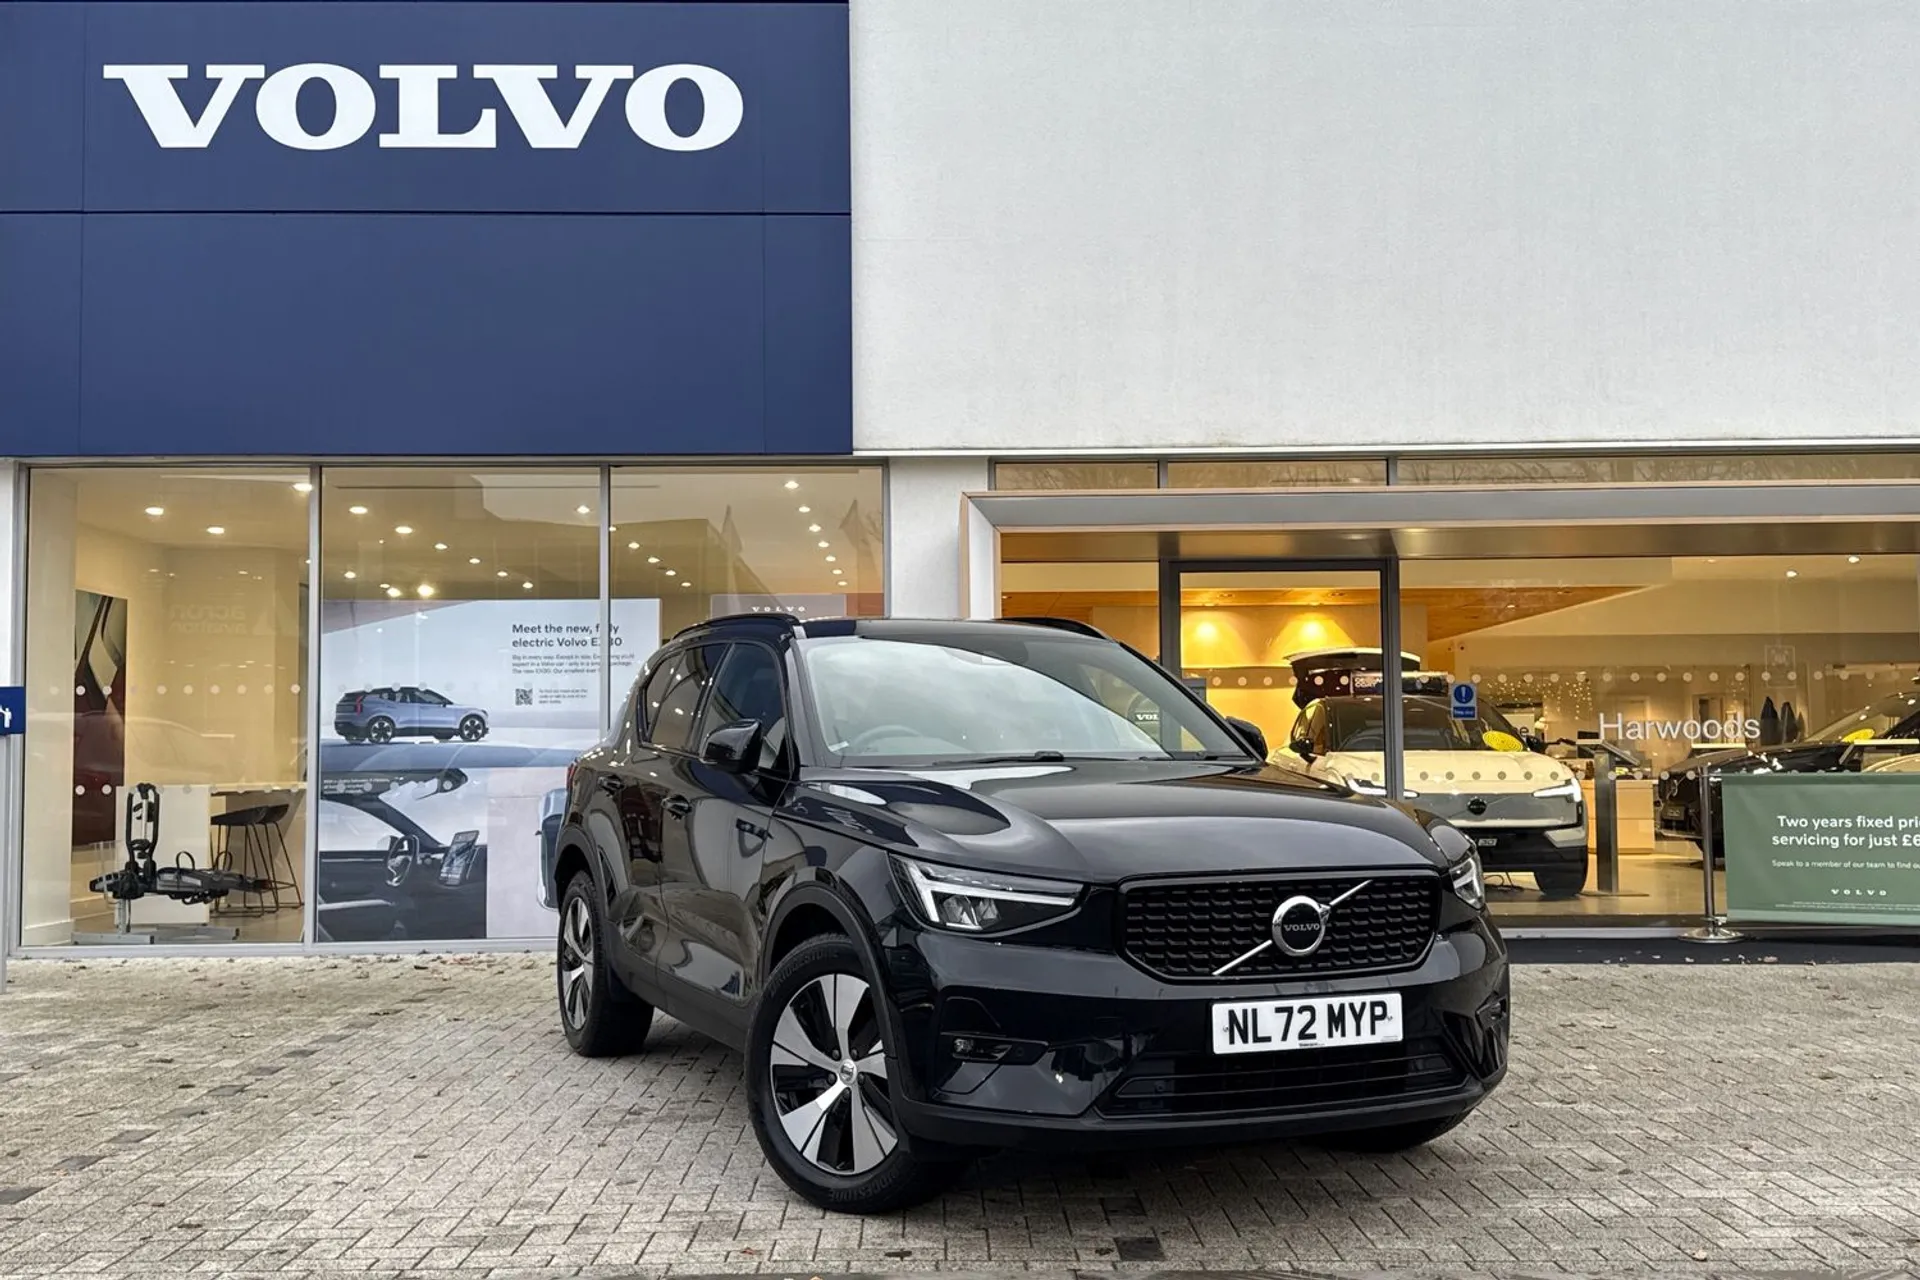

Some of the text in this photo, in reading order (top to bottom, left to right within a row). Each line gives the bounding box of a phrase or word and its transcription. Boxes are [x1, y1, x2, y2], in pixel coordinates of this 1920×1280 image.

[103, 62, 743, 151] VOLVO
[512, 624, 542, 634] Meet
[544, 623, 563, 634] the
[566, 625, 593, 635] new,
[512, 637, 623, 647] electric Volvo E30
[1599, 712, 1761, 740] Harwoods
[1776, 815, 1920, 831] Two years fixed pri
[1772, 833, 1839, 849] servicing
[1844, 833, 1865, 846] for
[1868, 833, 1898, 849] just
[1772, 859, 1794, 868] Speak
[1811, 860, 1842, 868] member
[1843, 860, 1851, 868] of
[1831, 888, 1887, 896] VOLVO
[1283, 922, 1320, 932] VOLVO
[1228, 1000, 1388, 1045] NL72 MYP
